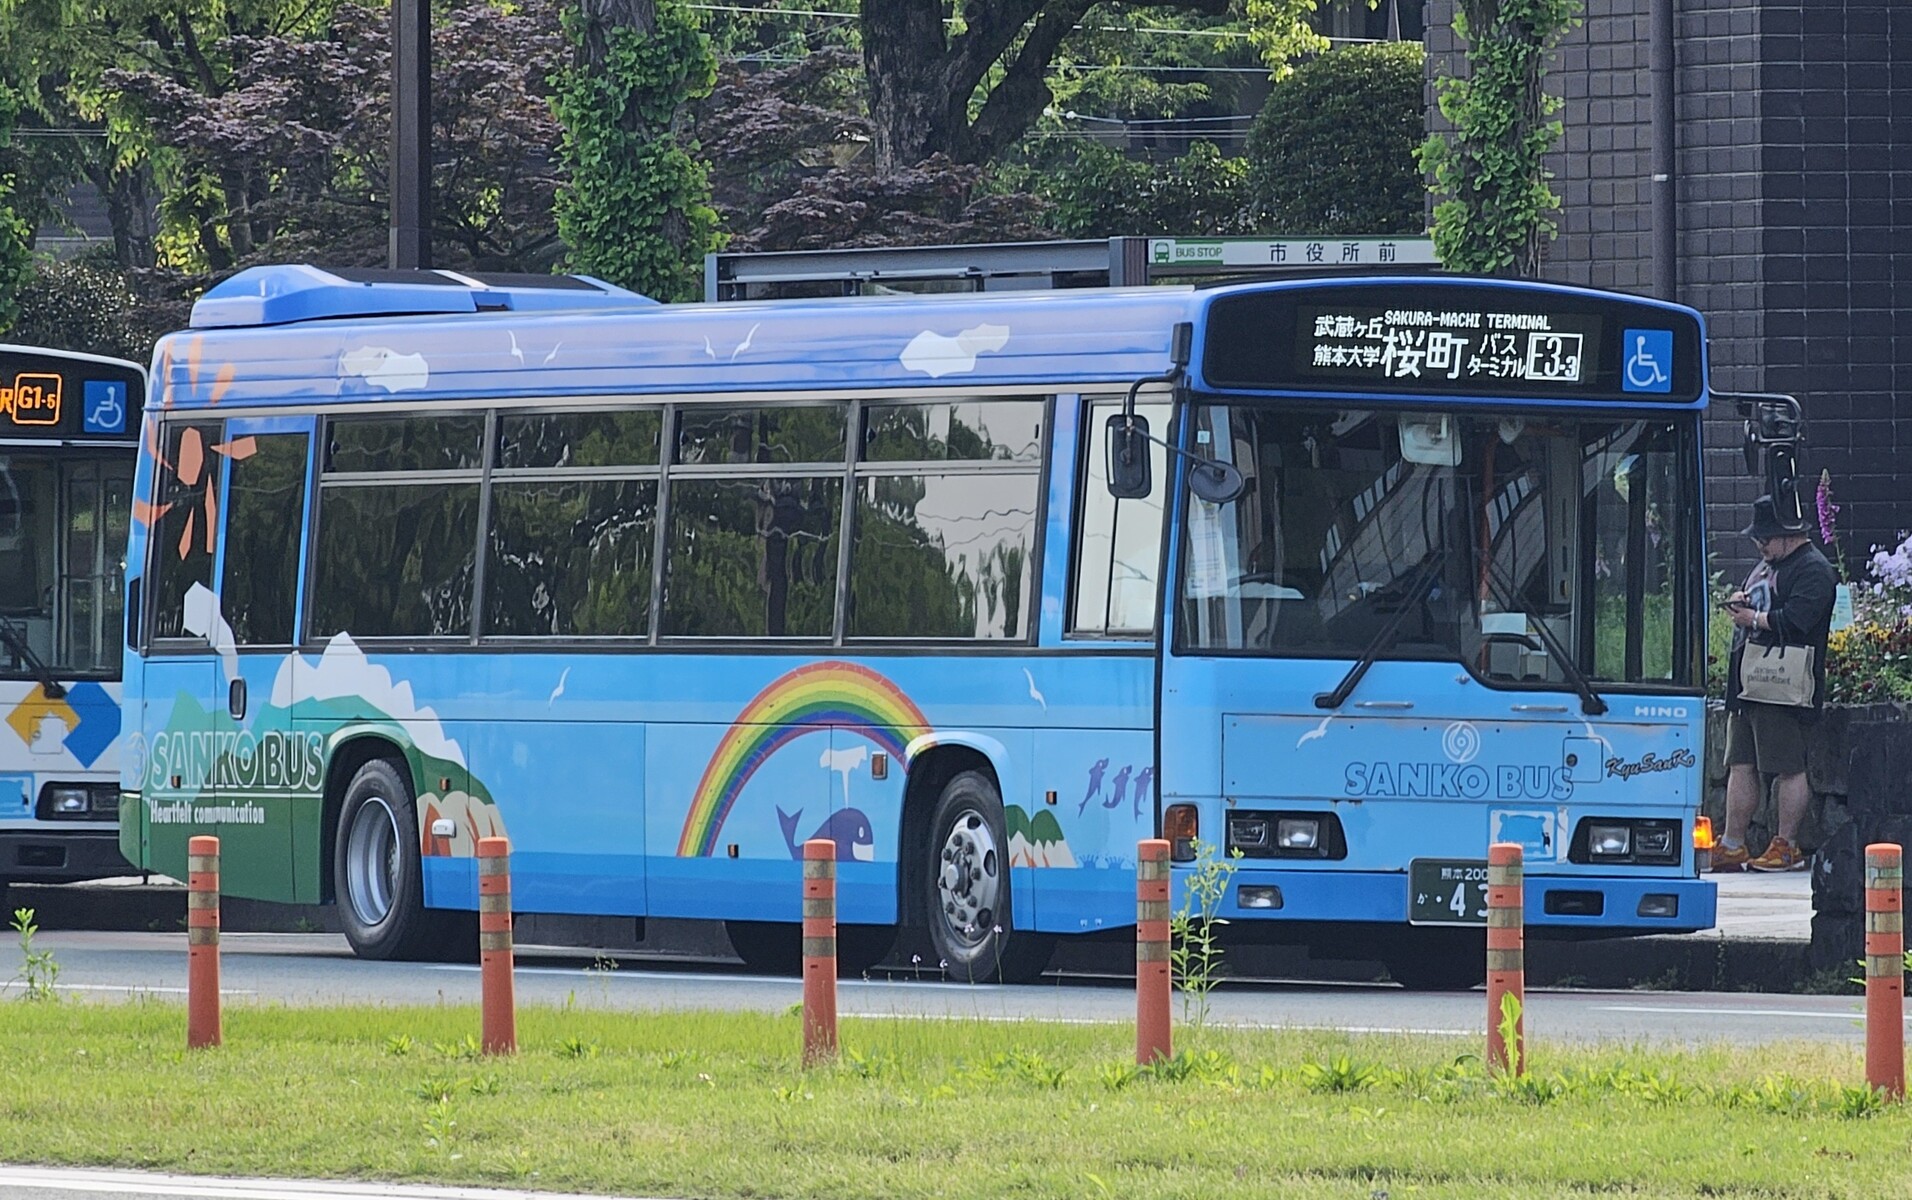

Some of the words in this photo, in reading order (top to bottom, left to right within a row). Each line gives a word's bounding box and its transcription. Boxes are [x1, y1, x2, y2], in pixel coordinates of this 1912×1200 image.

[1175, 247, 1195, 258] BUS
[1197, 247, 1223, 258] STOP
[1269, 243, 1397, 262] 市役所前
[1384, 310, 1481, 328] SAKURA-MACHI
[1487, 313, 1551, 330] TERMINAL
[1380, 327, 1469, 379] 桜町
[1479, 333, 1517, 354] バス
[1312, 344, 1380, 368] 熊本大学
[1634, 706, 1688, 718] HINO
[151, 729, 258, 790] SANKO
[262, 731, 324, 791] BUS
[1344, 762, 1490, 797] SANKO
[1497, 765, 1574, 799] BUS
[150, 800, 192, 824] Heartfelt
[194, 800, 265, 824] communication
